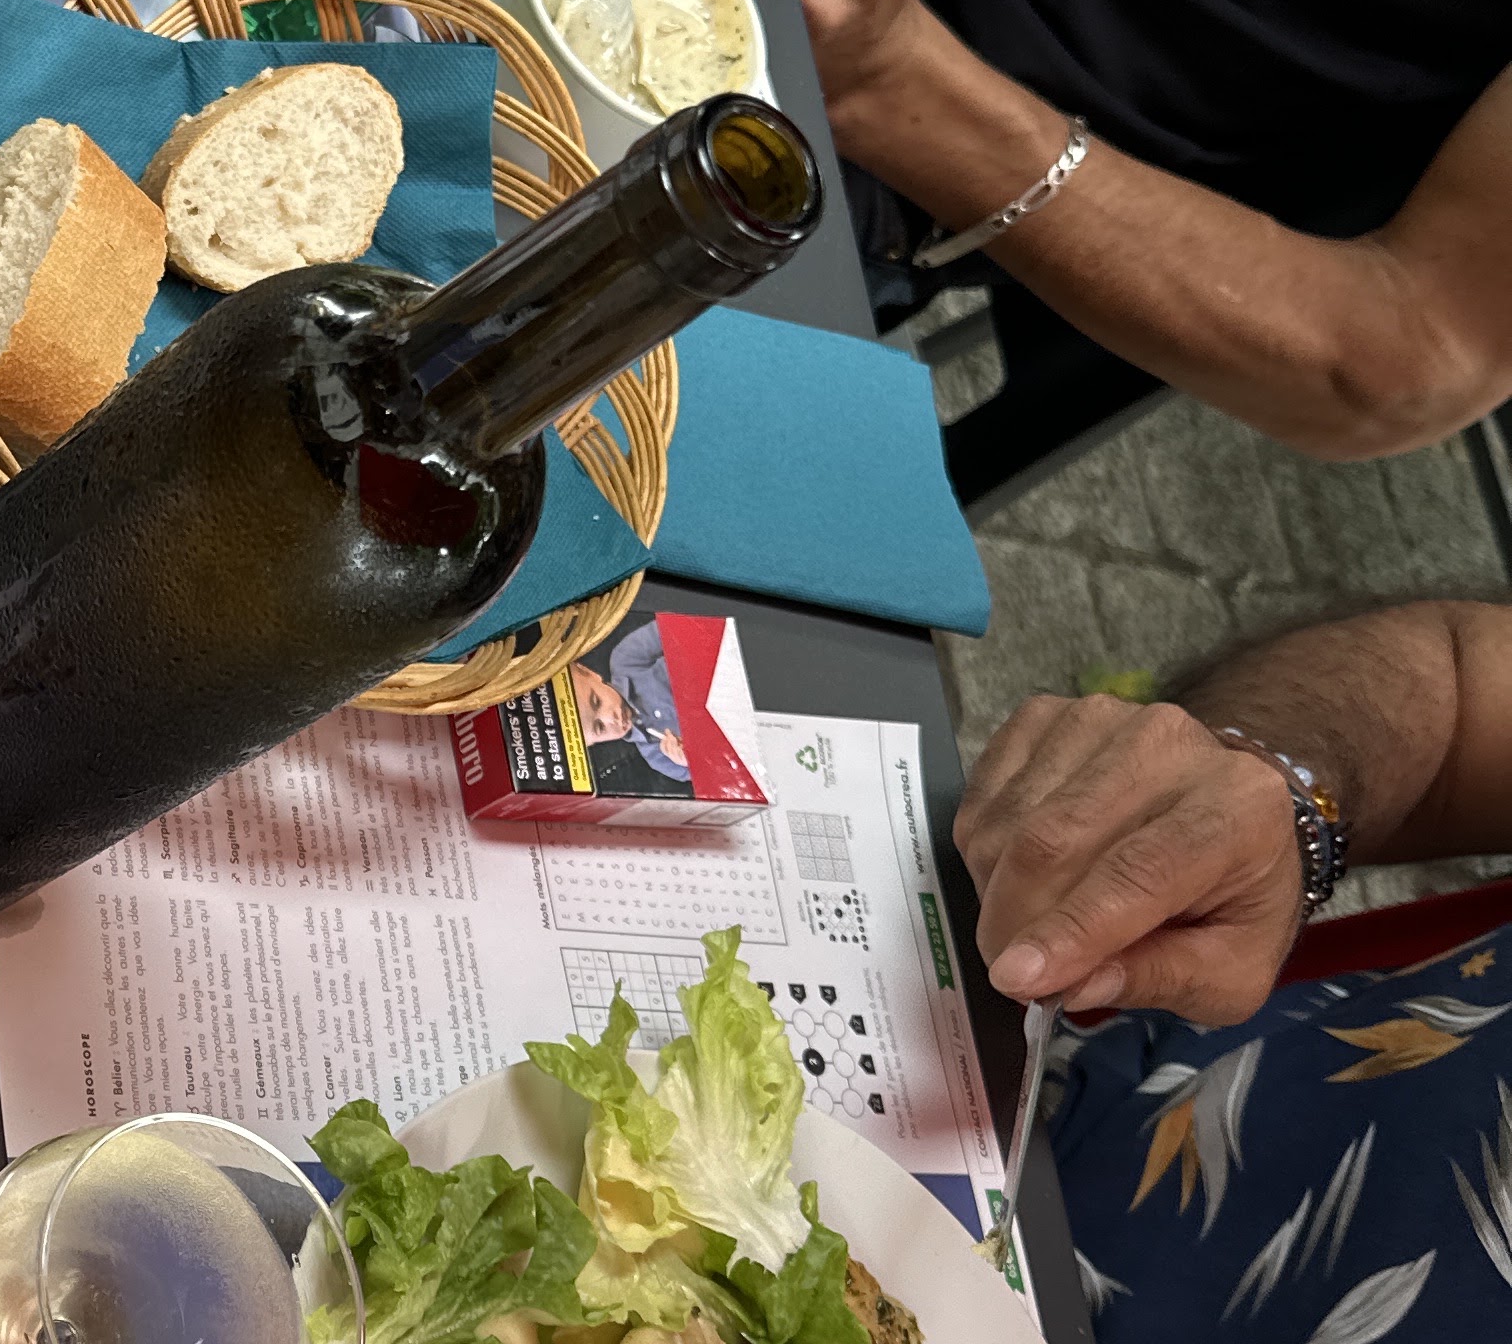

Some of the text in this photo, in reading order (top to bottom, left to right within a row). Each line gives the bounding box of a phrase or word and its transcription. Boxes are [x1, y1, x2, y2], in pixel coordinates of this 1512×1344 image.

[506, 711, 530, 780] Smokers'
[525, 714, 542, 753] more
[536, 683, 564, 781] to start smok
[533, 755, 547, 780] are
[225, 808, 241, 864] Sagittaire
[290, 805, 308, 868] Capricorne
[893, 757, 926, 874] www.autocrea.fr
[357, 828, 372, 873] Verseau
[420, 836, 434, 878] Poisson
[526, 844, 551, 930] Mots mélangés
[94, 893, 124, 1095] Bélier Vous allez découvrir que la
[126, 895, 154, 1083] Vous constaterez que vos idées
[80, 1032, 97, 1116] HOROSCOPE
[181, 1045, 195, 1097] Taureau
[251, 1037, 266, 1098] Gémeaux
[323, 1054, 335, 1100] Cancer
[392, 1075, 404, 1101] Lion
[968, 1108, 989, 1158] CONTACT
